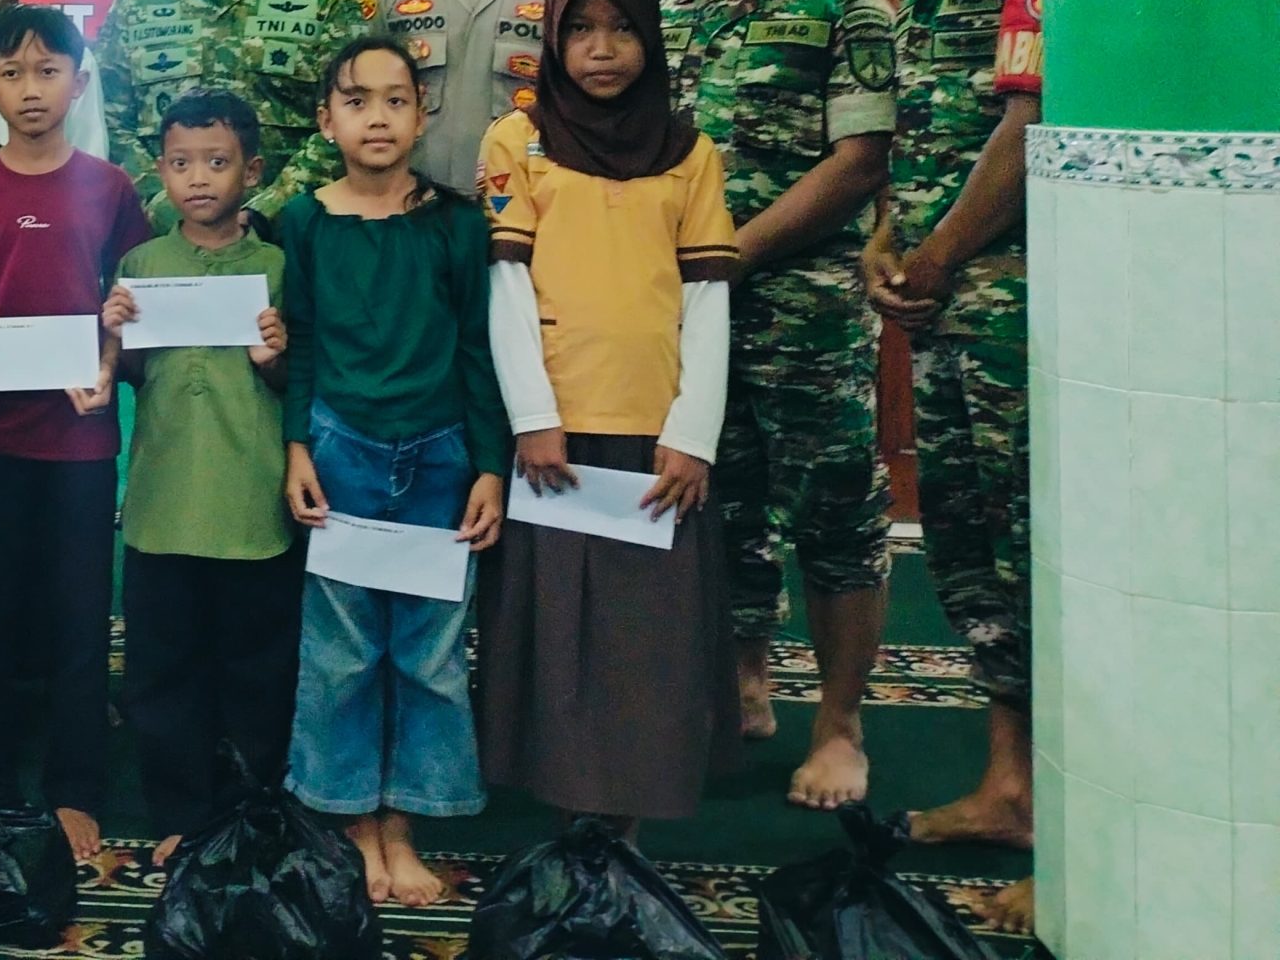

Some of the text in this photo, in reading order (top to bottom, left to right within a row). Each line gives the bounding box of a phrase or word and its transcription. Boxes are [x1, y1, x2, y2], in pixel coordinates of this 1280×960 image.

[256, 20, 316, 36] TNI AD
[499, 21, 542, 40] POL
